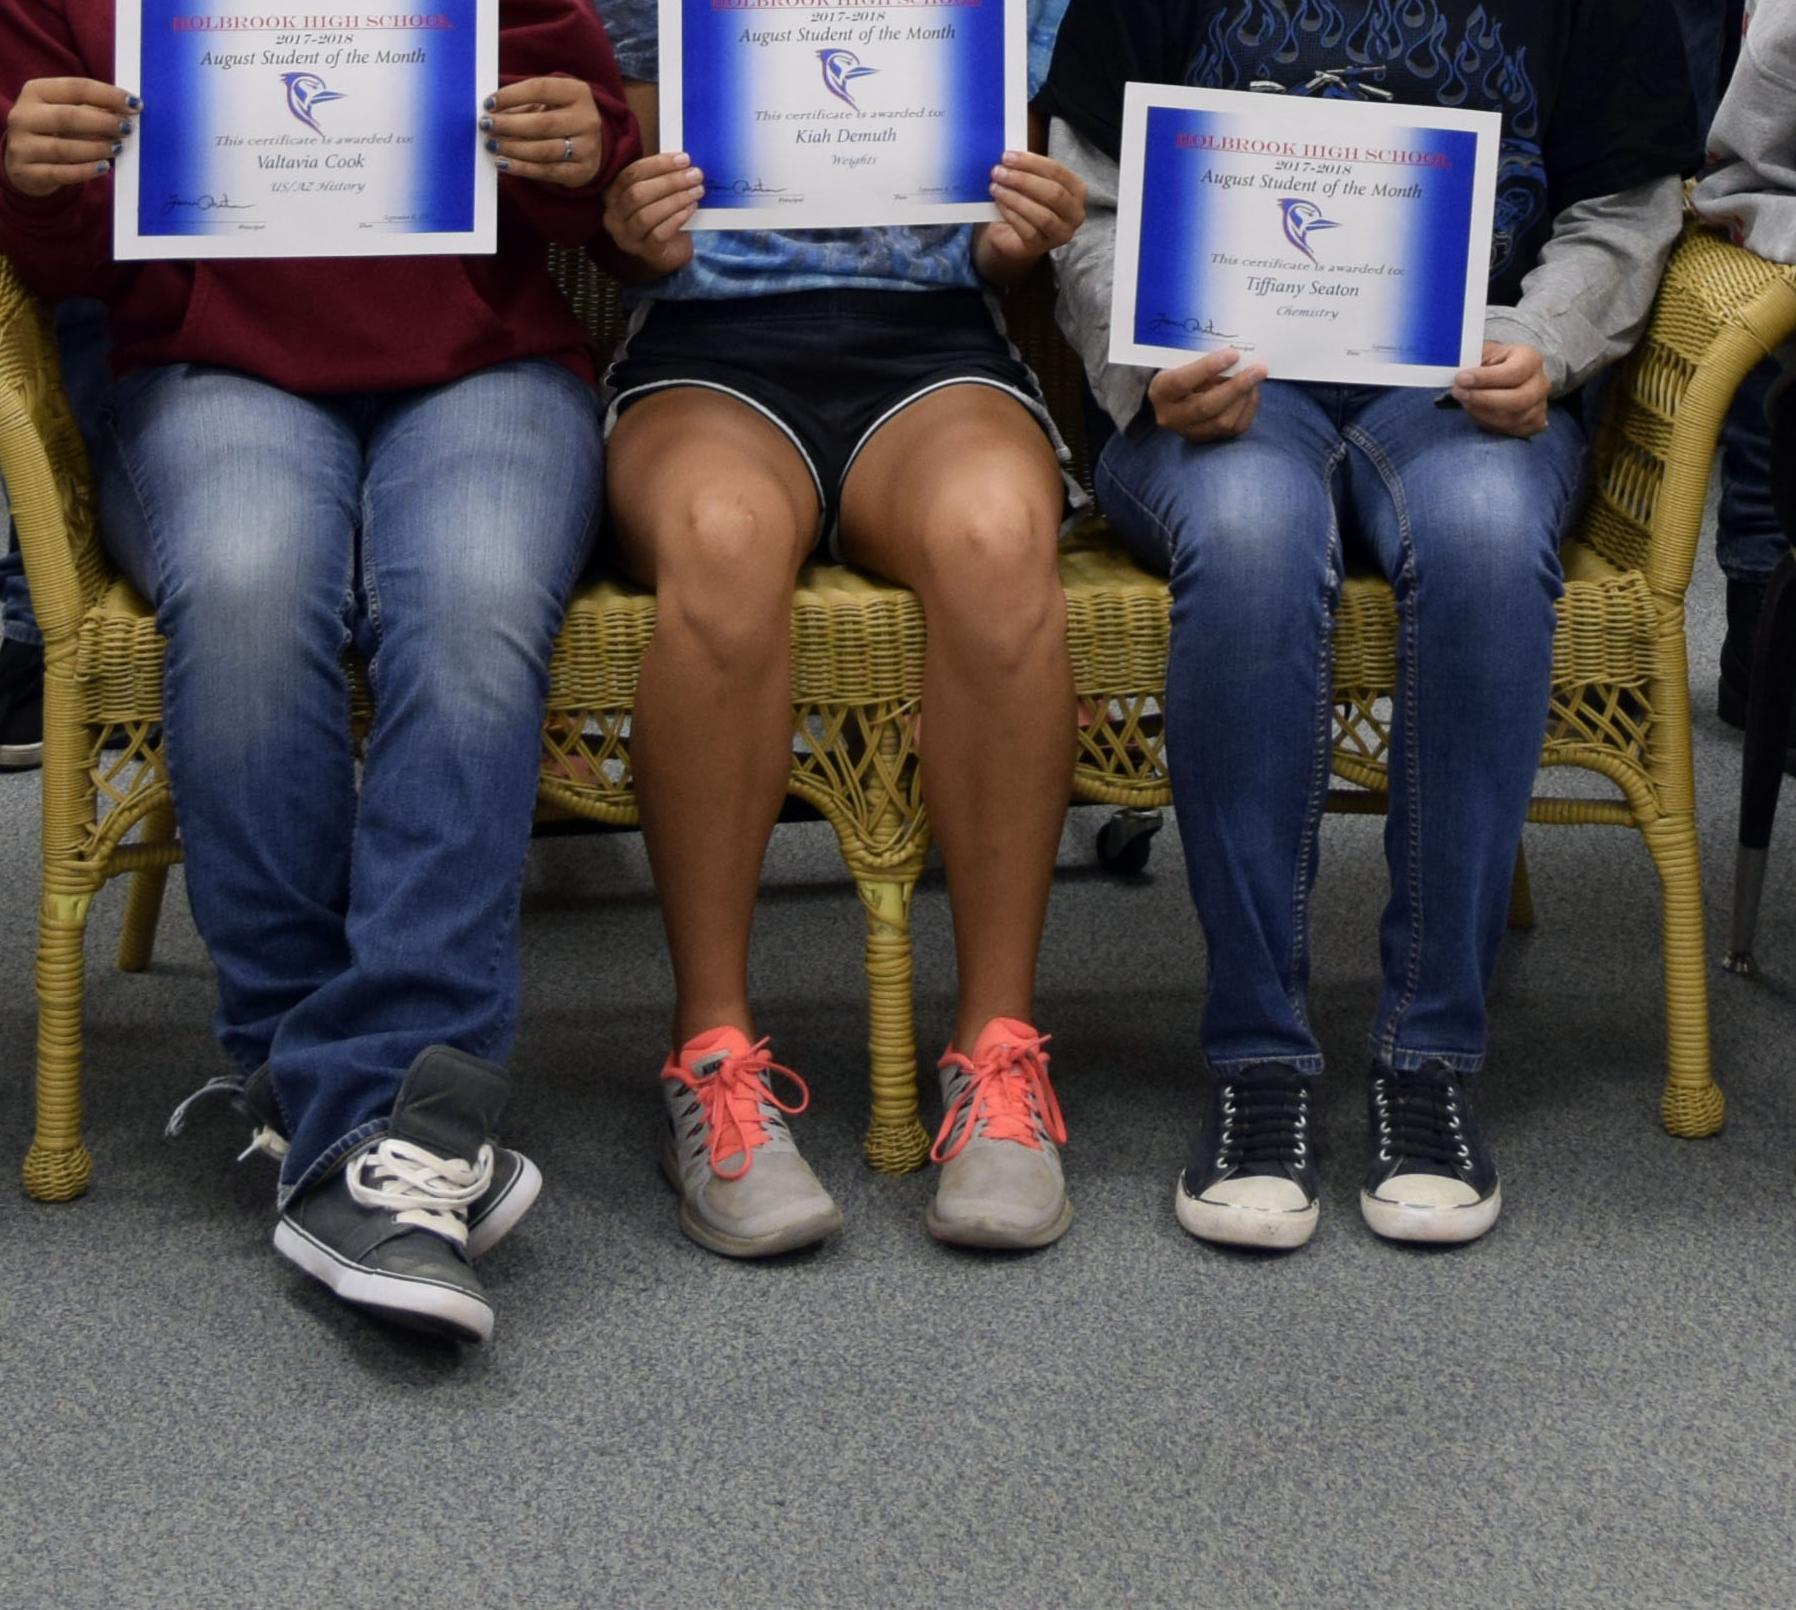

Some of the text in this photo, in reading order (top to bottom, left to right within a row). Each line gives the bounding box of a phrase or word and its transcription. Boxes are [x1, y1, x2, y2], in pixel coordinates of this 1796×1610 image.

[172, 14, 452, 30] HOLBROOK HIGH SCHOOL
[809, 10, 886, 23] 2017-2018
[274, 32, 354, 45] 2017-2018
[738, 23, 956, 47] August Student of the Month
[199, 47, 427, 70] August Student of the Month
[795, 127, 897, 144] Kiah Demuth
[1175, 133, 1450, 167] HOLBROOK HIGH SCHOOL
[257, 152, 366, 170] Valtavia Cook
[1273, 158, 1353, 176] 2017-2018
[1199, 168, 1423, 200] August Student of the Month
[1308, 279, 1359, 298] Seaton
